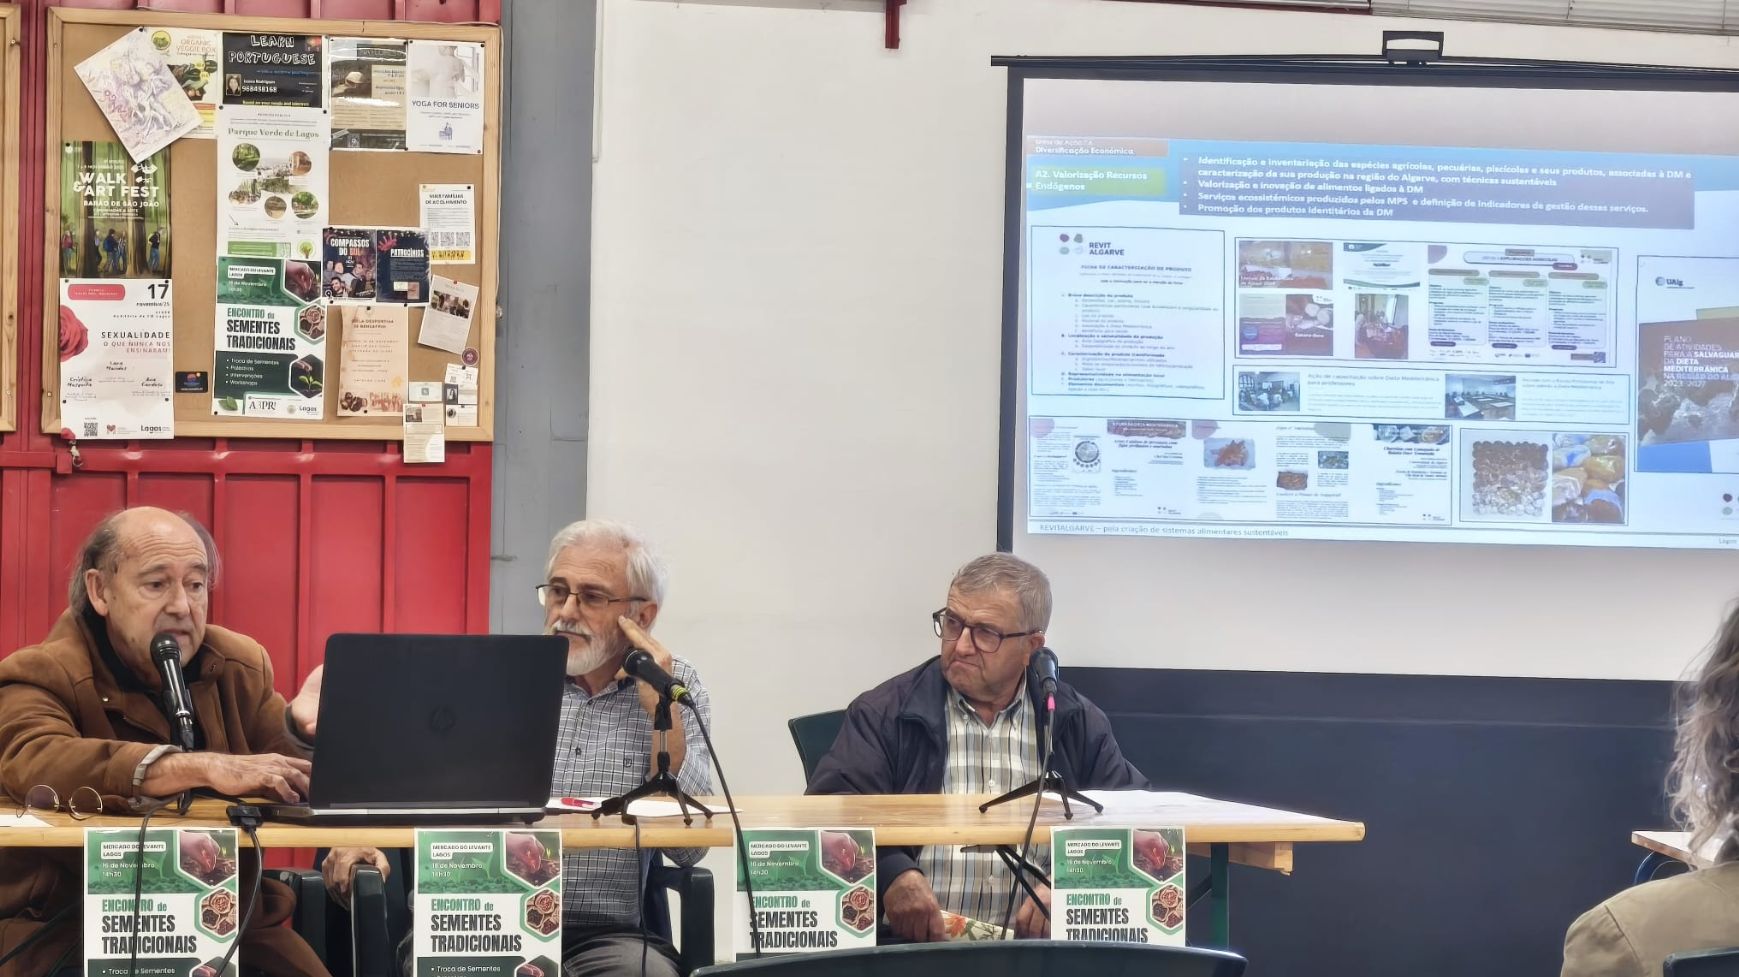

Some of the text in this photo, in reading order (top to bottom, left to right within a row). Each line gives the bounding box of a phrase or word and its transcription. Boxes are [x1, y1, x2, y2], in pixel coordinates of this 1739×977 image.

[250, 35, 295, 48] LEARN
[228, 51, 316, 65] PORTUGUESE
[448, 102, 480, 110] SENIORS
[228, 127, 320, 139] Parque Verde de Lagos
[1035, 146, 1089, 155] Diversificação
[1198, 156, 1258, 167] Identificação
[1268, 158, 1330, 168] inventariação
[1332, 160, 1349, 168] das
[1351, 161, 1389, 170] espécies
[1392, 162, 1435, 172] agrícolas,
[1437, 164, 1484, 173] pecuárias,
[1486, 164, 1528, 174] piscícolas
[1562, 167, 1606, 177] produtos,
[1608, 169, 1657, 178] associadas
[1659, 169, 1665, 178] à
[1667, 170, 1684, 179] DM
[79, 172, 127, 184] WALK
[1035, 170, 1148, 180] A2. Valorização Recursos
[1198, 169, 1263, 179] caracterização
[1265, 170, 1278, 178] da
[1297, 171, 1341, 180] produção
[1356, 173, 1385, 182] região
[1387, 173, 1399, 181] do
[1401, 174, 1439, 184] Algarve,
[1462, 175, 1499, 184] técnicas
[1501, 176, 1557, 186] sustentáveis
[72, 180, 160, 198] & ART FEST
[1035, 181, 1085, 191] Endógenos
[1198, 180, 1250, 190] Valorização
[1260, 181, 1301, 191] inovação
[1303, 182, 1315, 190] de
[1317, 182, 1362, 192] alimentos
[1365, 184, 1400, 194] ligados
[1407, 186, 1424, 194] DM
[139, 200, 160, 208] JOÃO
[1198, 192, 1236, 202] Serviços
[1238, 193, 1305, 202] ecossistémicos
[1307, 195, 1358, 205] produzidos
[1360, 196, 1385, 206] pelos
[1387, 197, 1408, 205] MPS
[1420, 198, 1462, 208] definição
[1464, 199, 1476, 207] de
[1478, 199, 1530, 210] indicadores
[1532, 201, 1543, 210] de
[1545, 202, 1575, 212] gestão
[1577, 203, 1608, 212] desses
[1610, 205, 1649, 214] serviços.
[1198, 204, 1393, 216] Promoção dos produtos identitários da DM
[330, 238, 370, 248] COMPASSOS
[147, 283, 169, 299] 17
[227, 308, 275, 319] ENCONTRO de
[226, 319, 280, 334] SEMENTES
[101, 331, 171, 339] SEXUALIDADE
[226, 334, 296, 350] TRADICIONAIS
[1664, 365, 1729, 373] MEDITERRÂNICA
[140, 425, 162, 434] Lagos
[1040, 524, 1288, 537] REVITALGARVE pela criação de sistemas alimentares sustentáveis
[102, 899, 168, 912] ENCONRO de
[431, 898, 494, 911] ENCONTRO de
[801, 899, 811, 908] de
[1066, 894, 1122, 905] ENCONTRO de
[431, 914, 501, 932] SEMENTES
[1066, 908, 1129, 925] SEMENTES
[750, 931, 838, 948] TRADICIONAIS
[1066, 928, 1148, 943] TRADICIONAIS
[431, 935, 522, 952] TRADICIONAIS
[140, 967, 176, 975] Sementes
